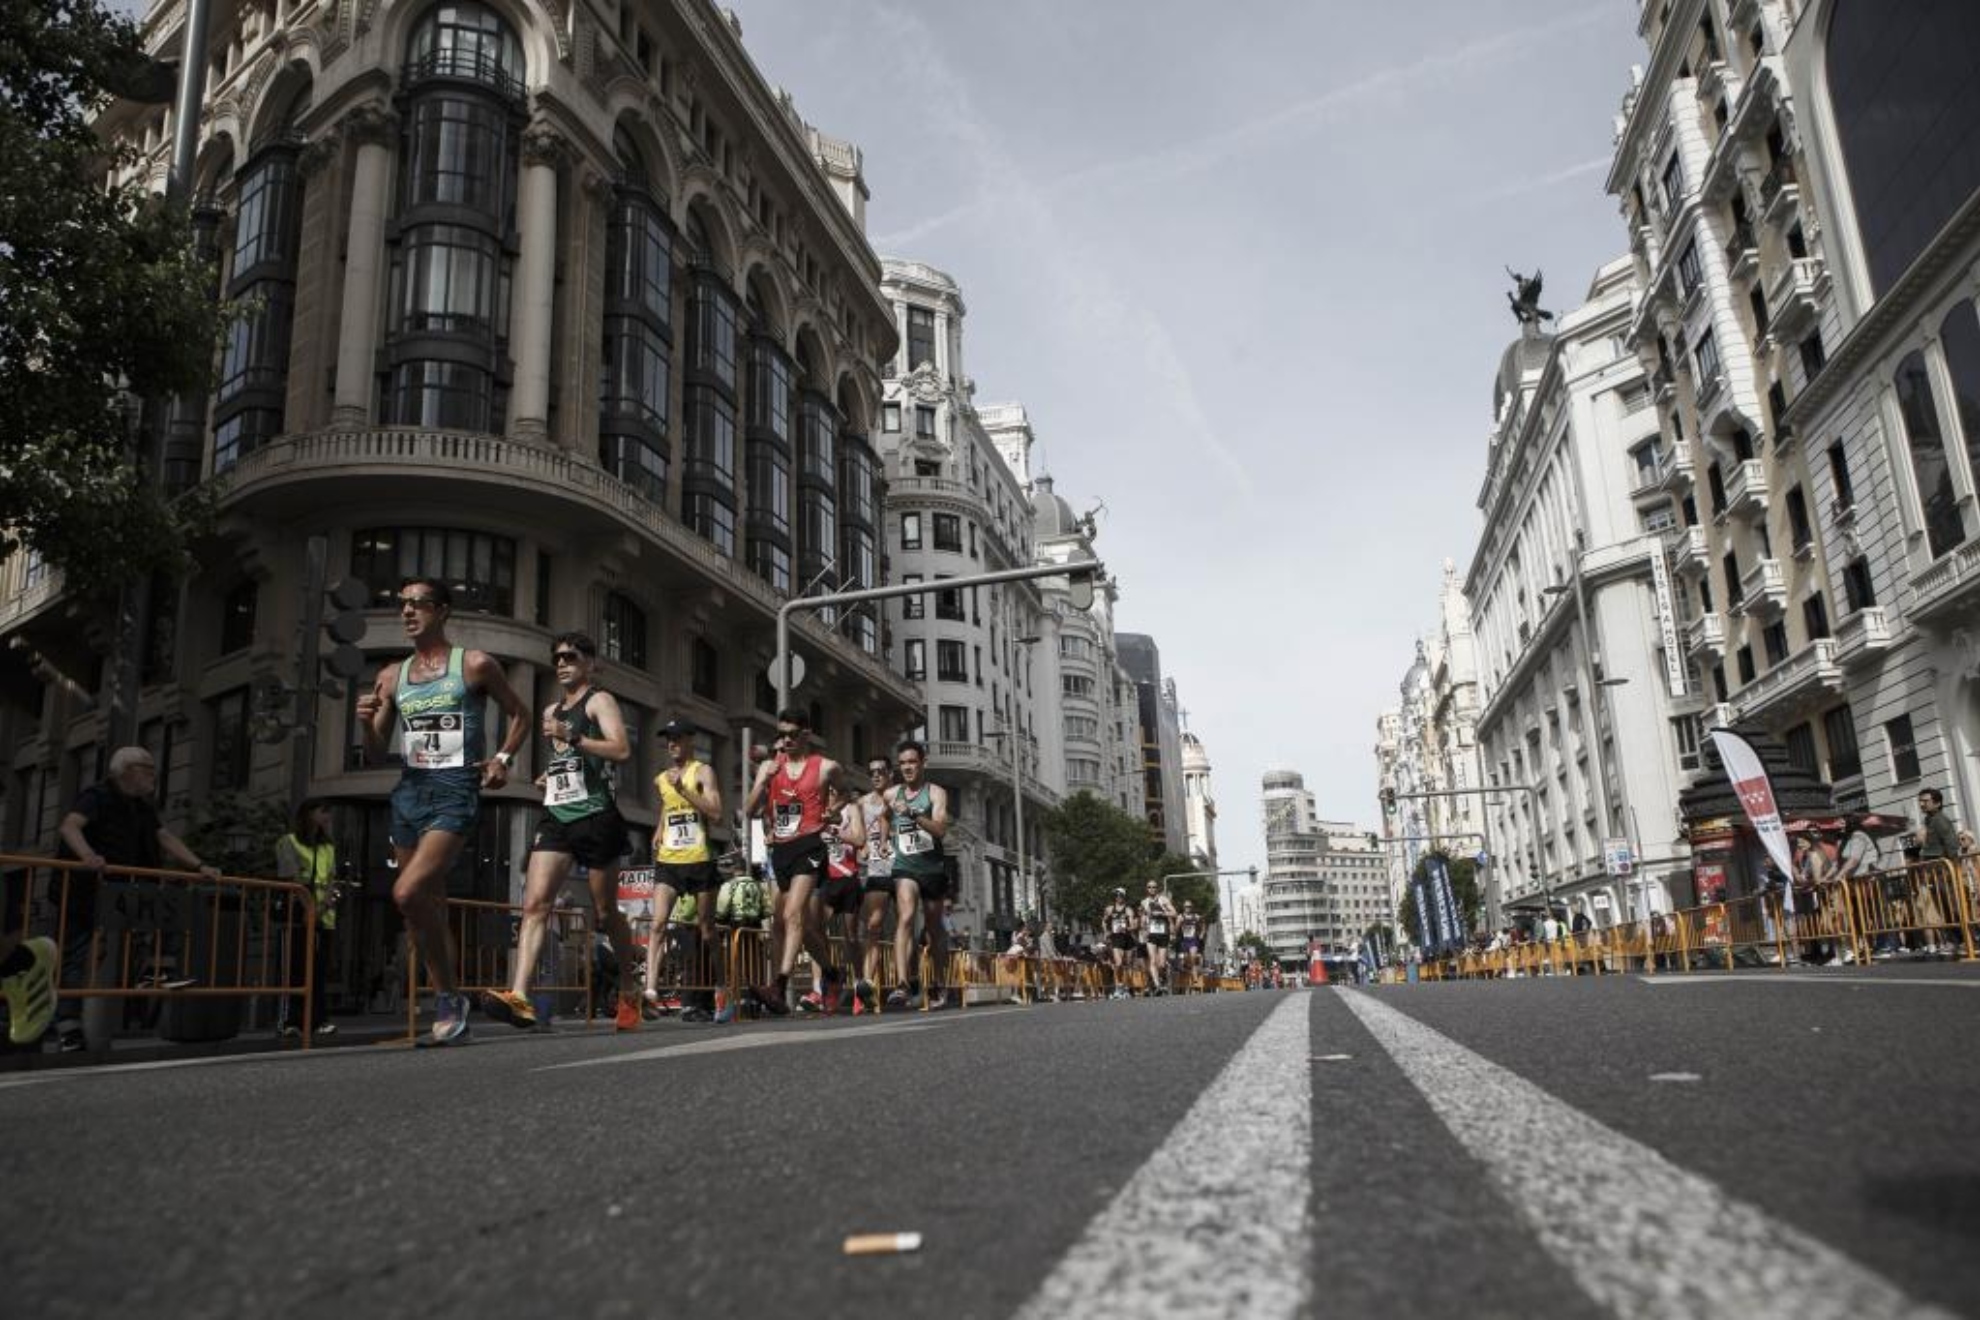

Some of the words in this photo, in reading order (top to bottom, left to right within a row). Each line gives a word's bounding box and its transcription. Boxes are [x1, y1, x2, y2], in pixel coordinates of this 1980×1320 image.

[1655, 555, 1666, 588] THIS
[1660, 593, 1669, 610] IS
[1663, 614, 1671, 623] A
[1665, 628, 1678, 673] HOTEL
[423, 733, 441, 751] 74
